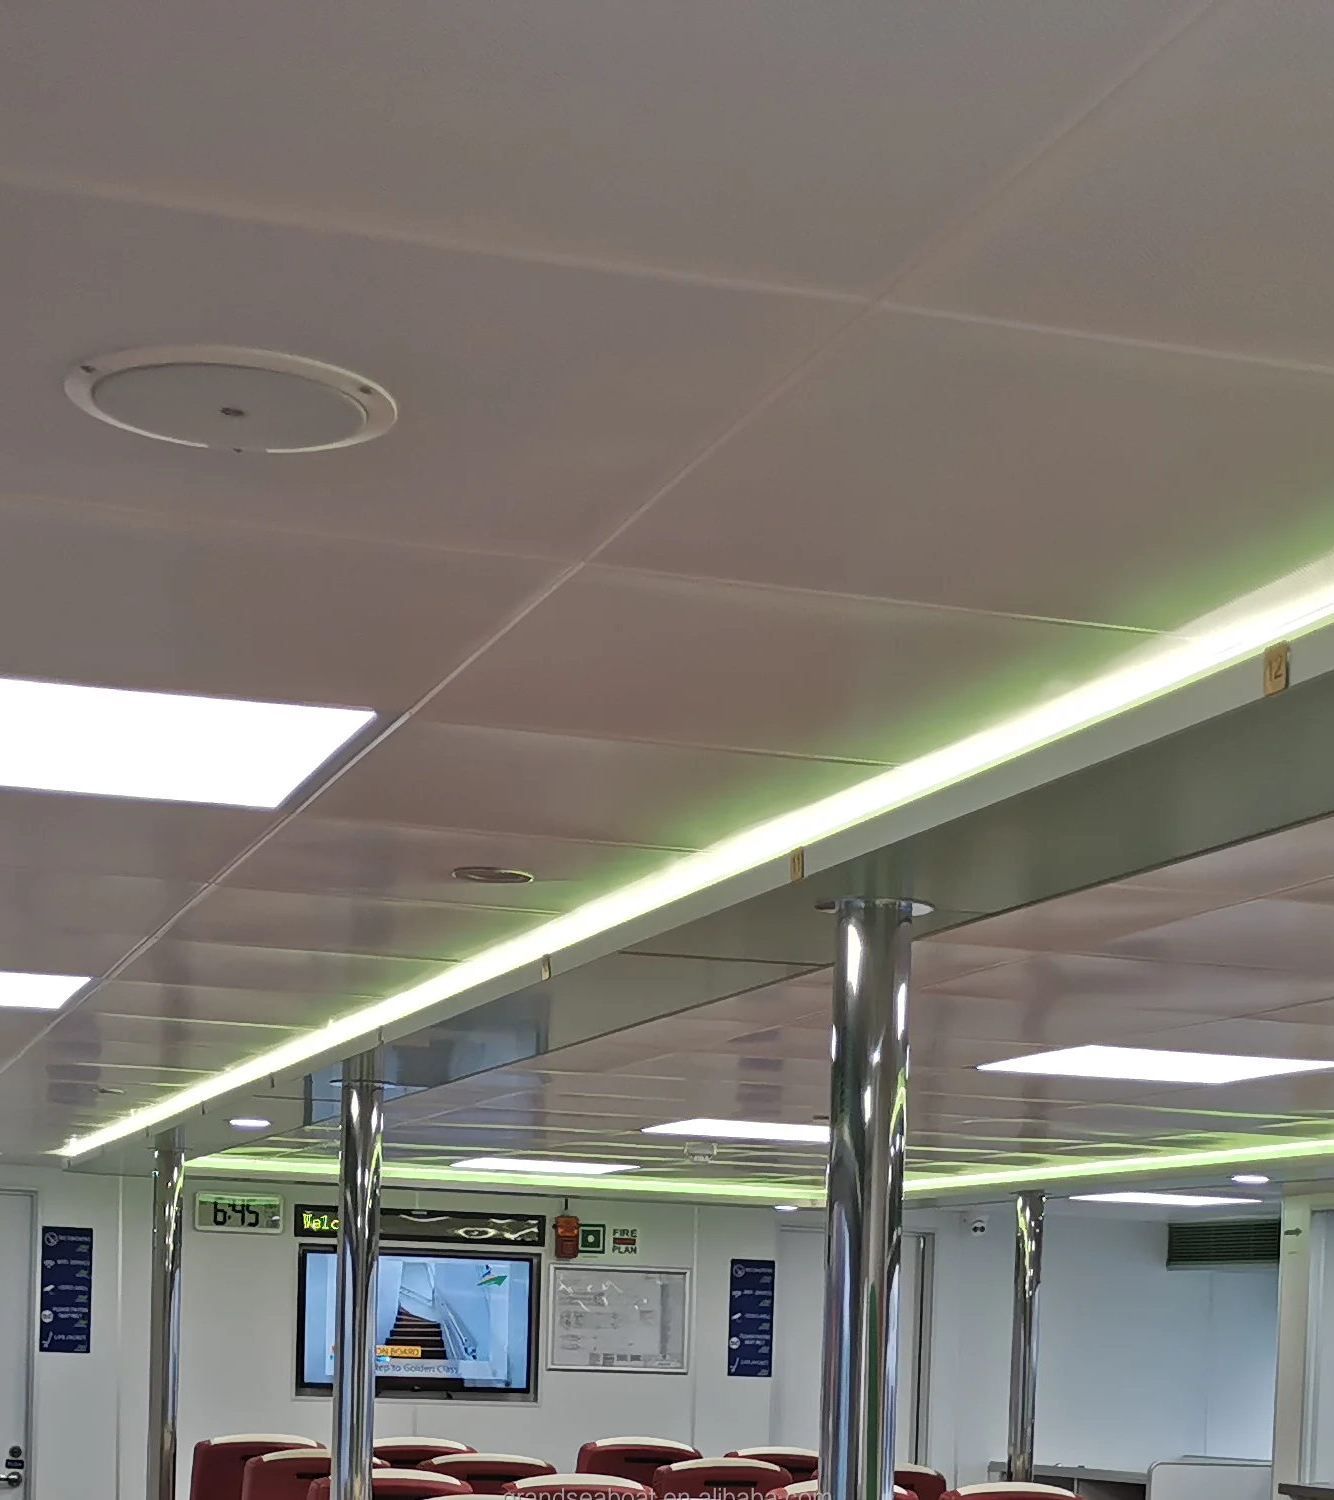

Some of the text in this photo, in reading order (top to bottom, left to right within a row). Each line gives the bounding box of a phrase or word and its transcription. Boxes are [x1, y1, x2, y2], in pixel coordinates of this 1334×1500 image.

[302, 1213, 340, 1231] Welc
[612, 1228, 638, 1238] FIRE
[612, 1245, 638, 1255] PLAN
